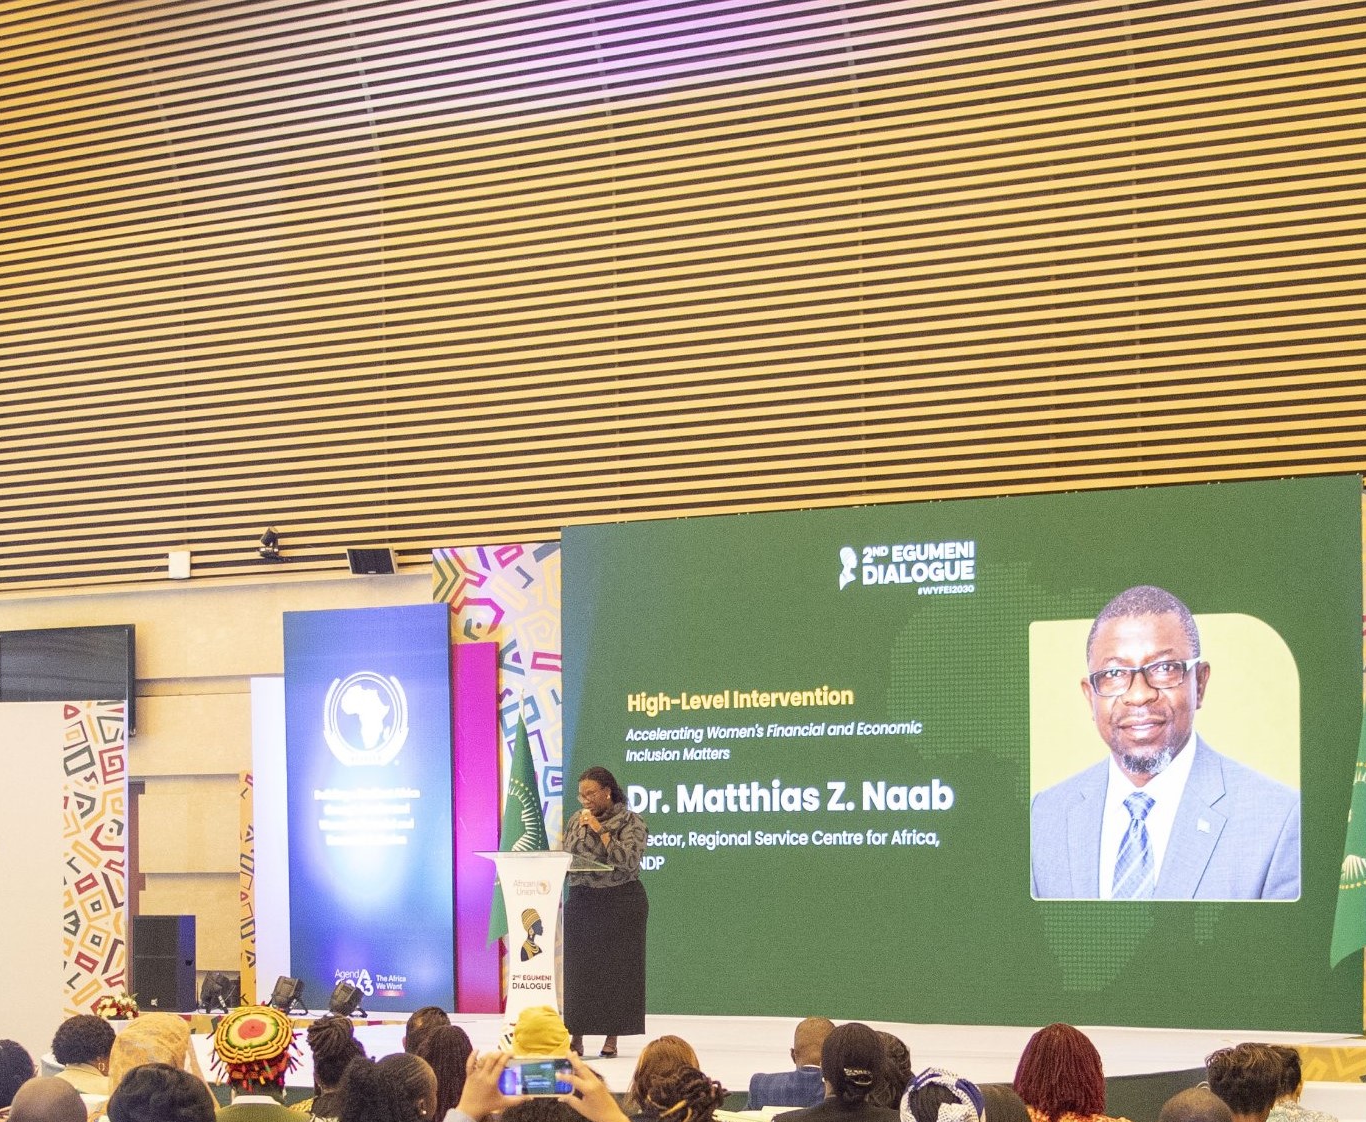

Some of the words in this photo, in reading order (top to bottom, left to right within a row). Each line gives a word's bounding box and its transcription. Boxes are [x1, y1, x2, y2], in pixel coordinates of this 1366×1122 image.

[863, 546, 889, 564] 2ND
[892, 541, 975, 562] EGUMENI
[863, 560, 975, 585] DIALOGUE
[918, 585, 975, 595] #WYFEI2030
[627, 690, 730, 717] High-Level
[733, 686, 854, 709] Intervention
[626, 726, 704, 743] Accelerating
[707, 724, 764, 739] Women's
[767, 723, 826, 738] Financial
[827, 722, 855, 736] and
[857, 720, 923, 736] Economic
[626, 748, 680, 762] Inclusion
[683, 748, 731, 761] Matters
[627, 785, 670, 814] Dr.
[677, 779, 820, 813] Matthias
[827, 782, 856, 812] Z.
[862, 779, 955, 811] Naab
[646, 832, 686, 849] ector,
[689, 830, 752, 850] Regional
[755, 830, 808, 846] Service
[812, 830, 864, 846] Centre
[866, 830, 888, 845] for
[891, 829, 940, 848] Africa,
[639, 856, 666, 871] NDP
